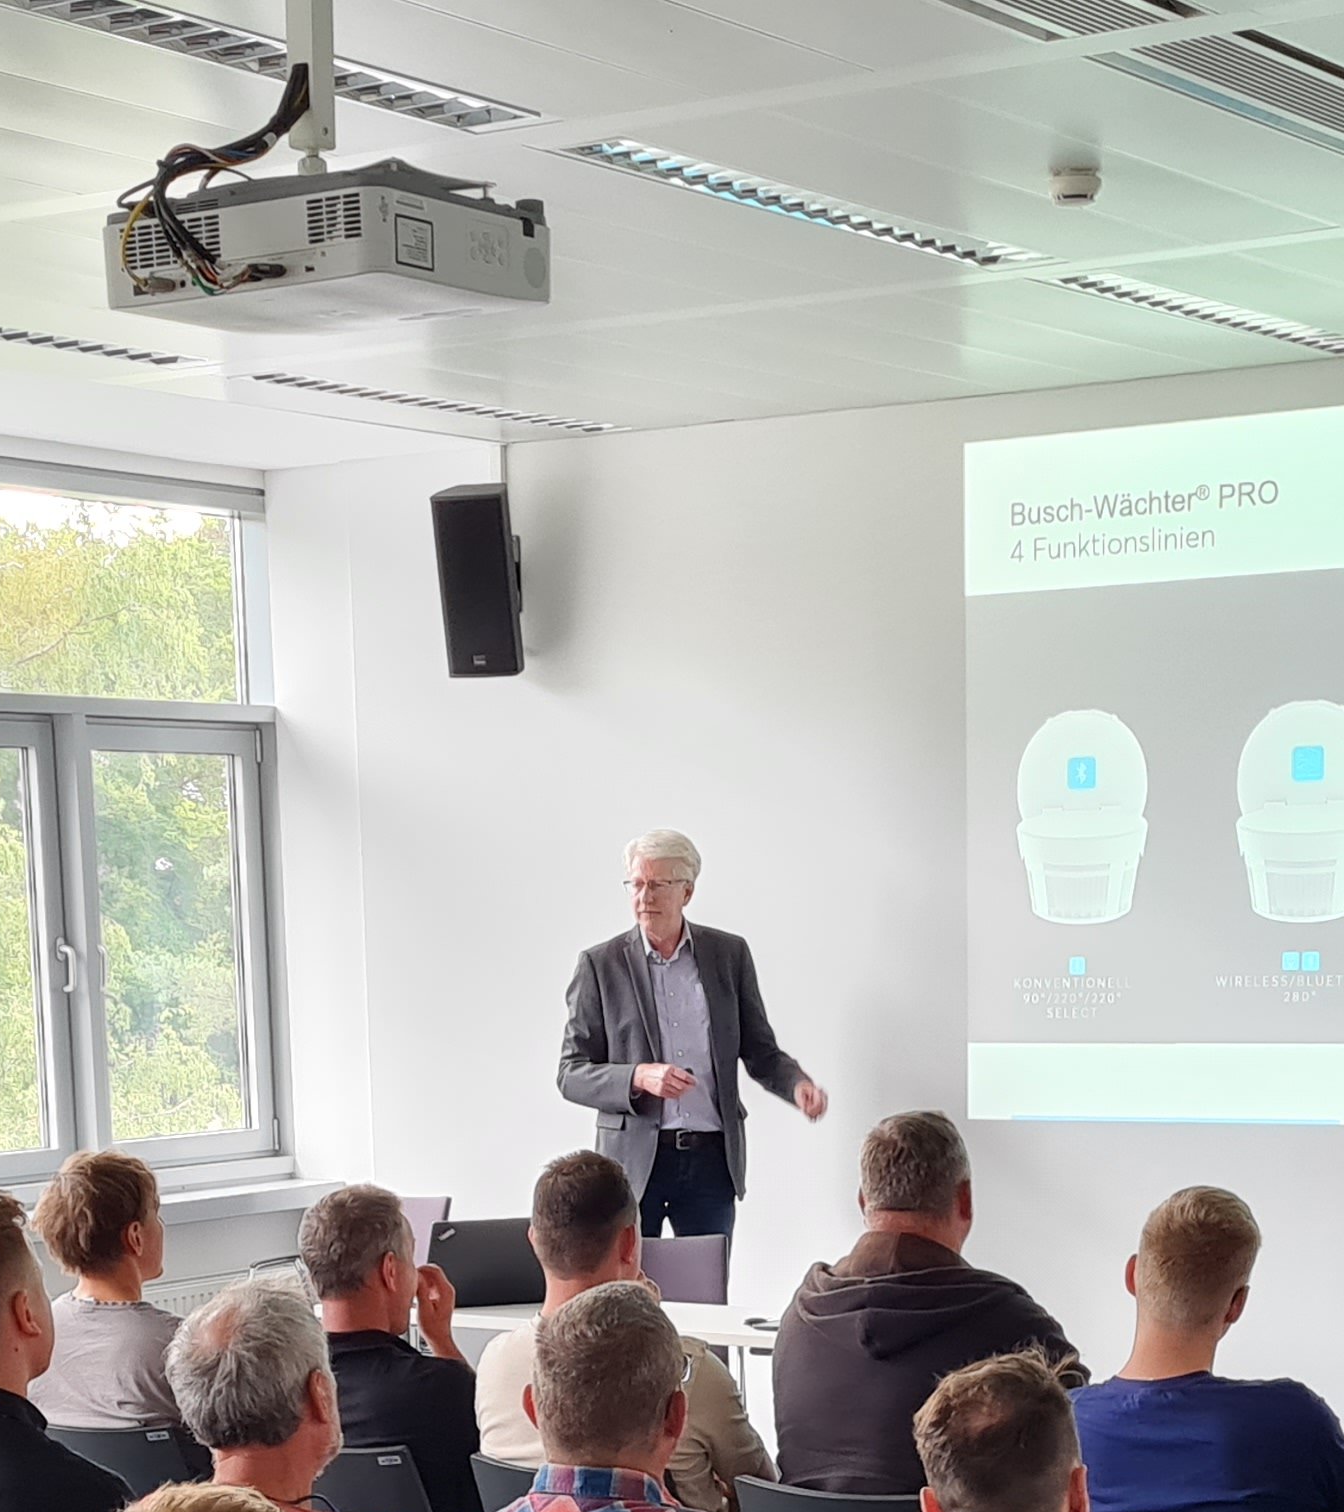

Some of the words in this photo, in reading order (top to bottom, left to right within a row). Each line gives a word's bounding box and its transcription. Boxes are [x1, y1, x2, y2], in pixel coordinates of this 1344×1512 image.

[1218, 480, 1279, 509] PRO
[1009, 539, 1025, 563] 4
[1033, 527, 1216, 562] Funktionslinien
[1013, 976, 1132, 990] KONVENTIONELL
[1046, 1006, 1098, 1019] SELECT
